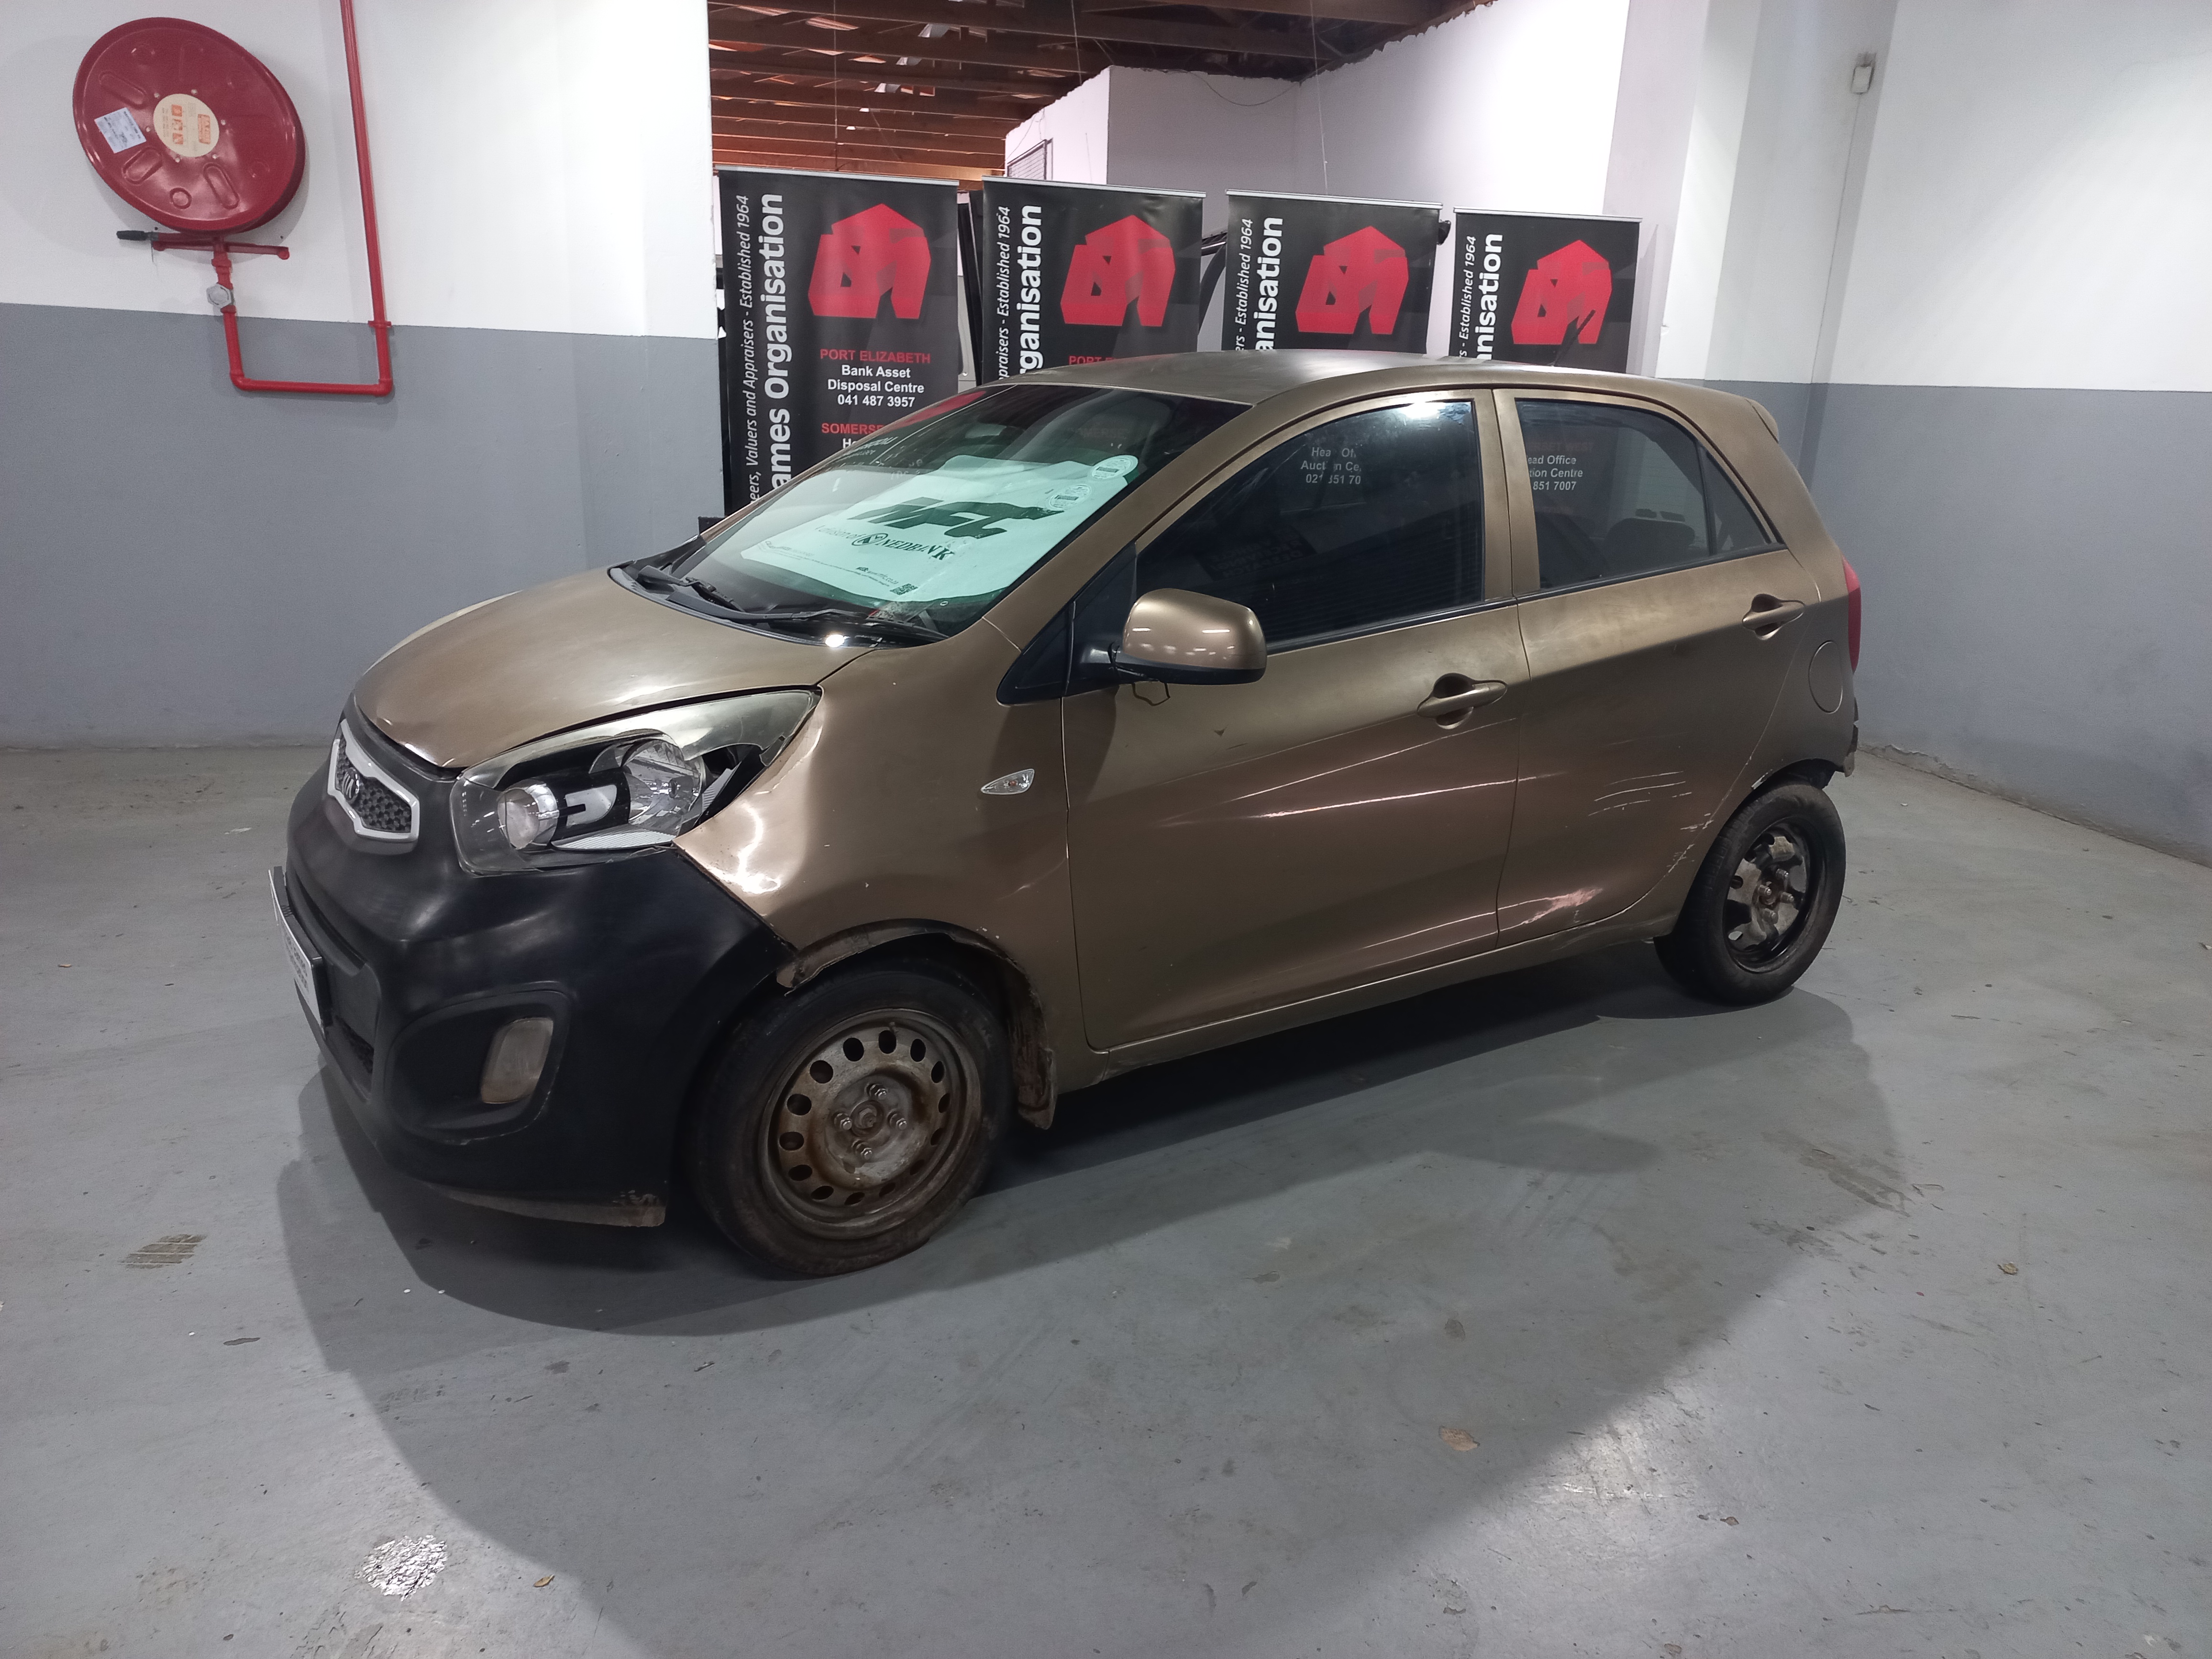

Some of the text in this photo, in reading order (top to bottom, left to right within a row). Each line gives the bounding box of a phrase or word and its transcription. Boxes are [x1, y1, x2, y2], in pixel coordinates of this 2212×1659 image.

[736, 195, 750, 228] 1964
[998, 206, 1010, 238] 1964
[1240, 219, 1253, 249] 1964
[1465, 236, 1476, 266] 1964
[736, 231, 752, 309] Established
[996, 242, 1010, 316] Established
[1235, 253, 1251, 325] Established
[1459, 269, 1473, 340] Established
[740, 319, 758, 389] Appraisers
[820, 349, 931, 364] PORT ELIZABETH
[995, 327, 1010, 380] praisers
[828, 379, 925, 393] Disposal Centre
[841, 364, 911, 378] Bank Asset
[742, 390, 757, 417] and
[837, 394, 916, 407] 041 487 3957
[744, 419, 759, 466] Valuers
[769, 409, 792, 489] ames
[1311, 447, 1331, 457] Hea
[1527, 455, 1577, 465] ead Office
[1550, 468, 1583, 477] Centre
[749, 472, 762, 504] eers,
[1533, 481, 1577, 490] 851 7007
